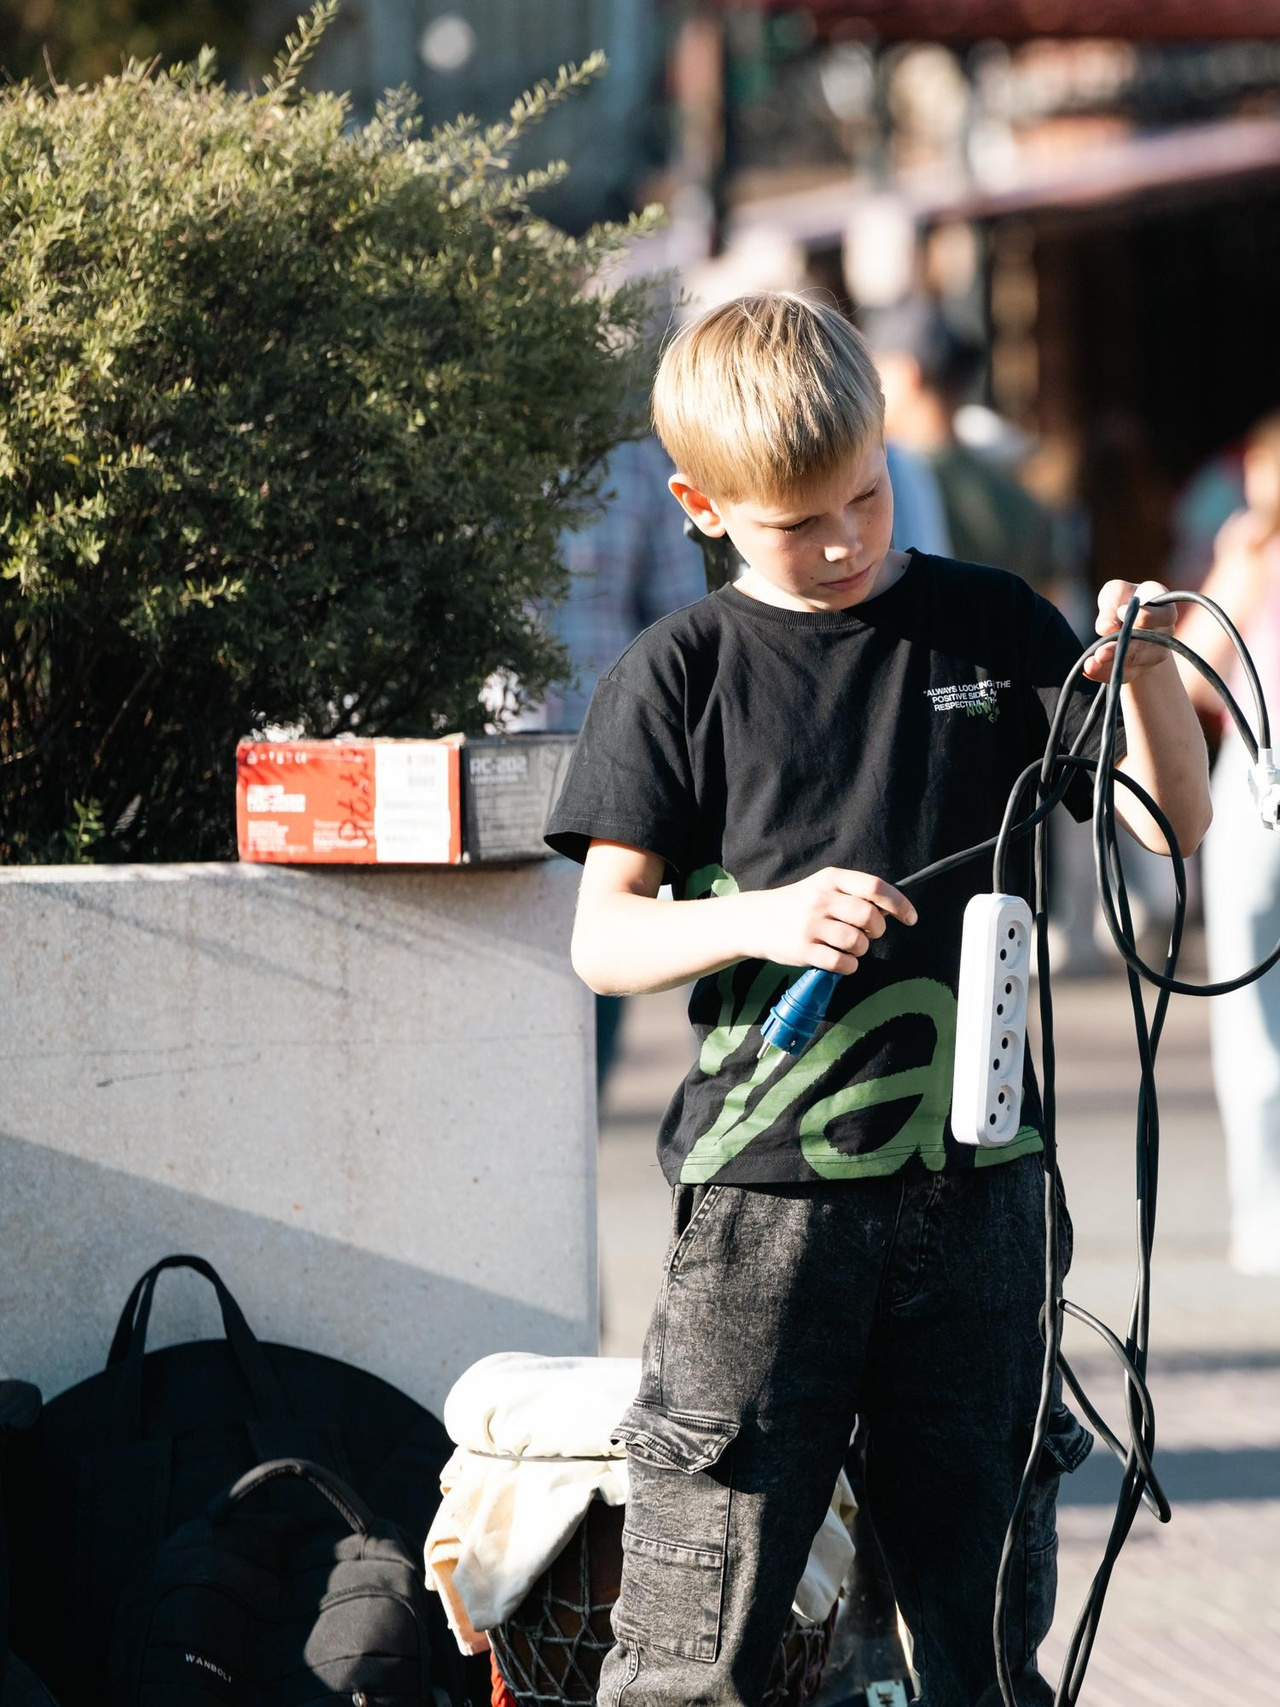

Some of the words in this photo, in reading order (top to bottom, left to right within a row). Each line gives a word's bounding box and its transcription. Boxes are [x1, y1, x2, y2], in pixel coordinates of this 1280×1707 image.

[958, 680, 993, 692] LOOKING
[995, 680, 1011, 689] THE
[932, 692, 968, 704] POSITIVE
[470, 755, 528, 776] RC-202
